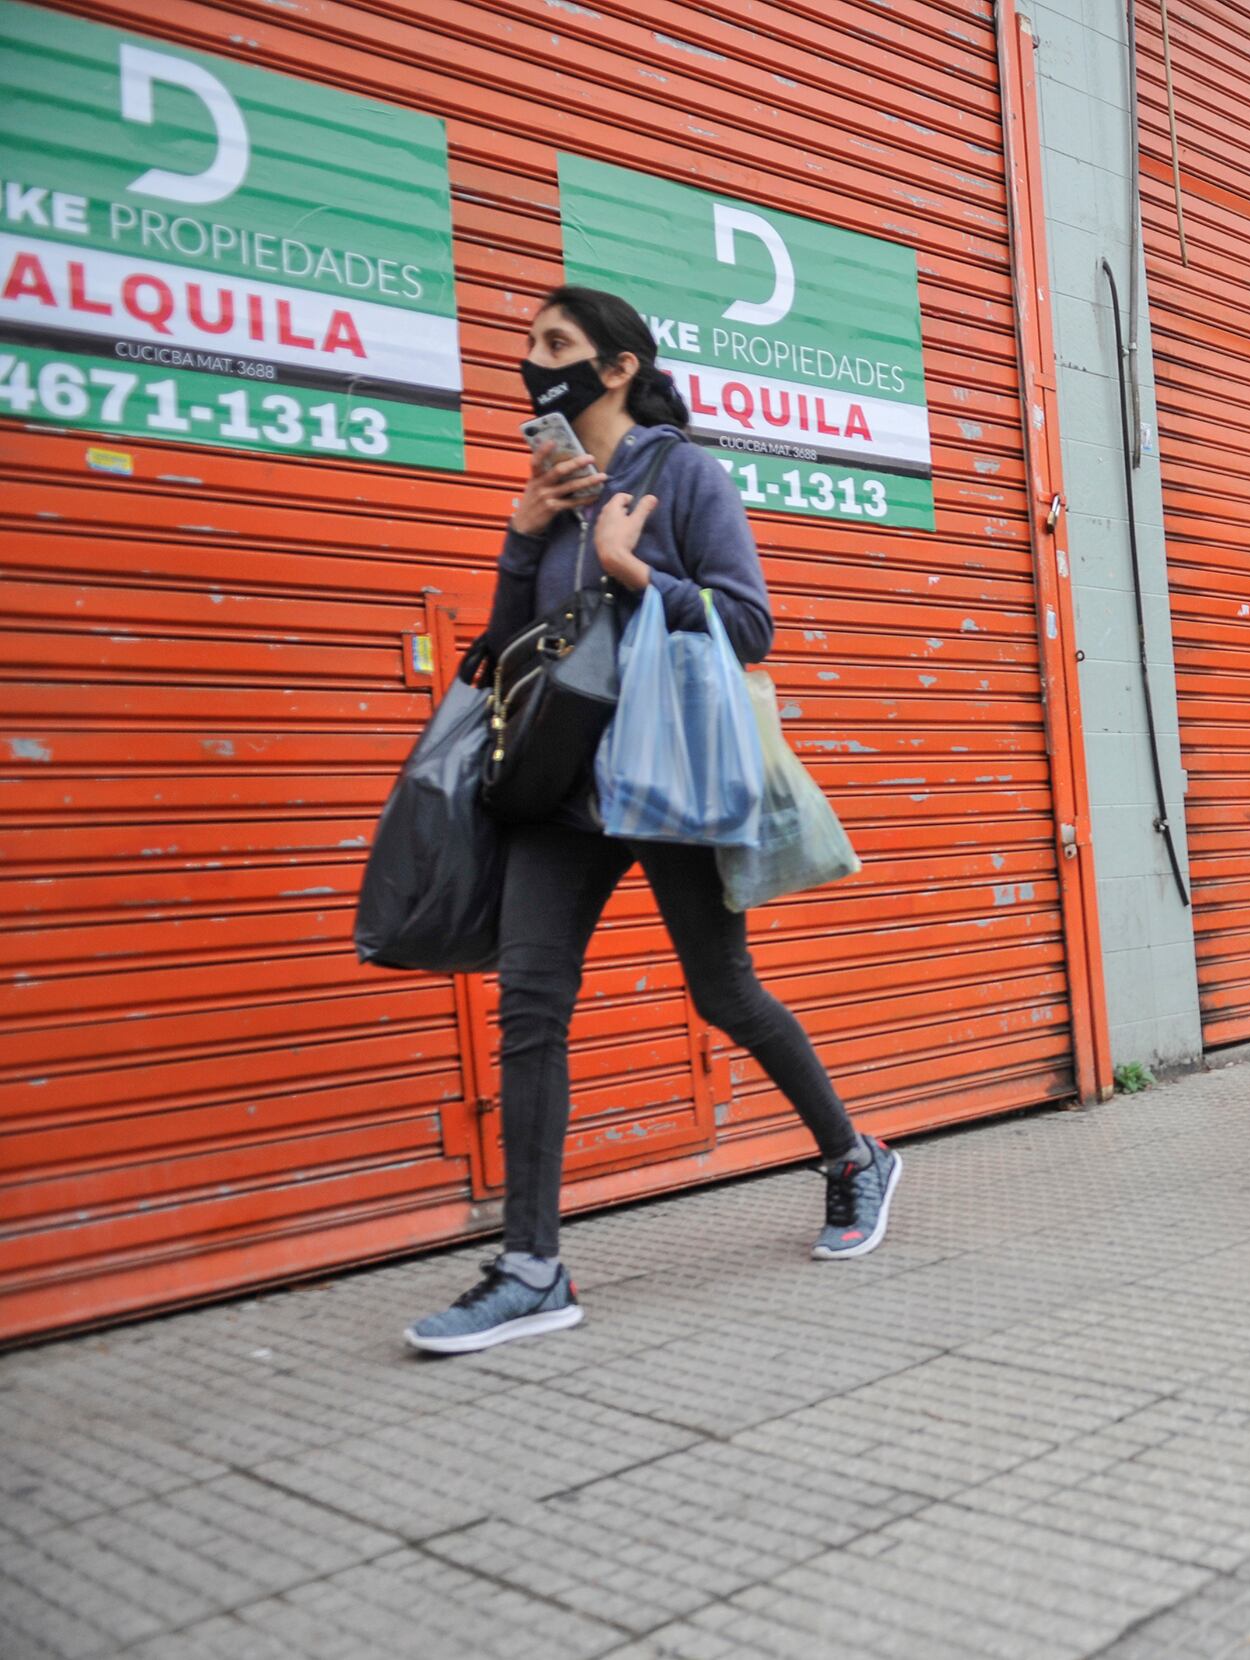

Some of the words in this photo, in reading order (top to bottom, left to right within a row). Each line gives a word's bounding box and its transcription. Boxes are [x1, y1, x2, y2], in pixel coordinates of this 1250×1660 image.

[0, 181, 90, 233] KE
[109, 203, 424, 299] PROPIEDADES
[2, 251, 368, 359] ALQUILA
[115, 342, 194, 367] CUCICBA
[197, 354, 234, 373] MAT.
[237, 360, 275, 379] 3688
[640, 313, 701, 353] KE
[712, 328, 905, 393] PROPIEDADES
[0, 354, 391, 456] 4671-1313
[660, 369, 873, 441] LQUILA
